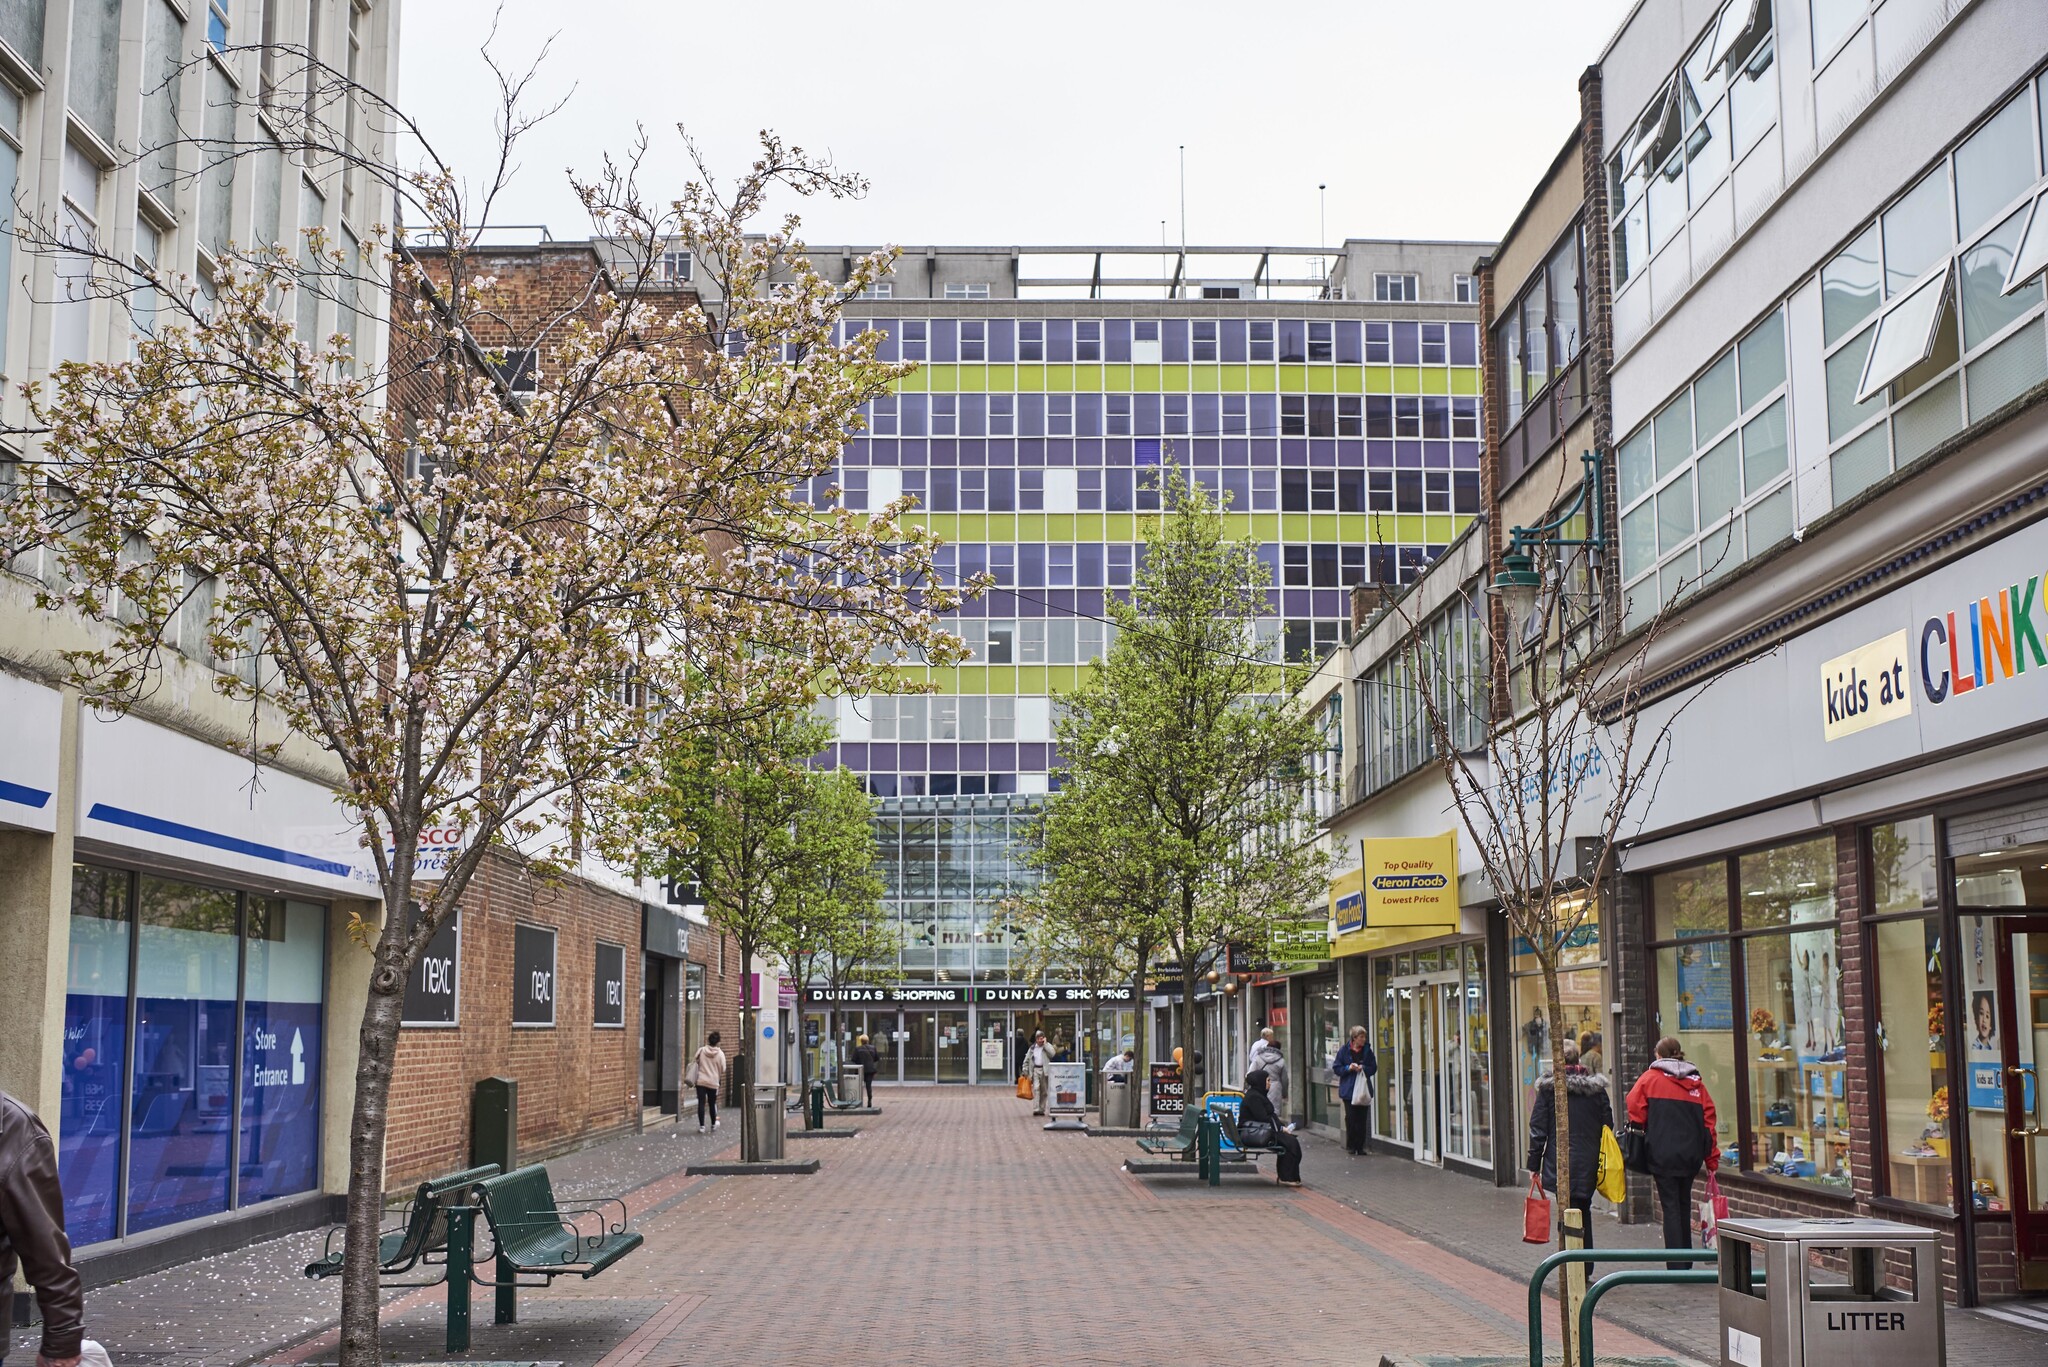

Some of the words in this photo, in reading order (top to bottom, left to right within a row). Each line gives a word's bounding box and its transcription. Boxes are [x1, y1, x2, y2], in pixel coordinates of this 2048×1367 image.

[1826, 667, 1869, 725] kids
[1880, 657, 1905, 706] at
[1920, 570, 2048, 706] CLINK
[386, 828, 462, 846] TSCO
[1384, 861, 1400, 871] Top
[1401, 860, 1434, 870] Quality
[1376, 877, 1410, 888] Heron
[1411, 875, 1444, 887] Foods
[1382, 897, 1413, 905] Lowest
[1414, 895, 1440, 904] Prices
[1274, 930, 1328, 943] CHEF
[1301, 943, 1322, 952] Away
[1284, 952, 1328, 960] Restaurant
[422, 957, 451, 994] next
[531, 970, 551, 1001] next
[606, 979, 621, 1005] next
[813, 990, 884, 1000] DUNDAS
[892, 990, 956, 1001] SHOPPING
[985, 989, 1058, 1000] DUNDAS
[1065, 989, 1130, 1000] SHOPING
[255, 1027, 276, 1050] Store
[254, 1064, 288, 1087] Entrance
[1828, 1312, 1905, 1331] LITTER
